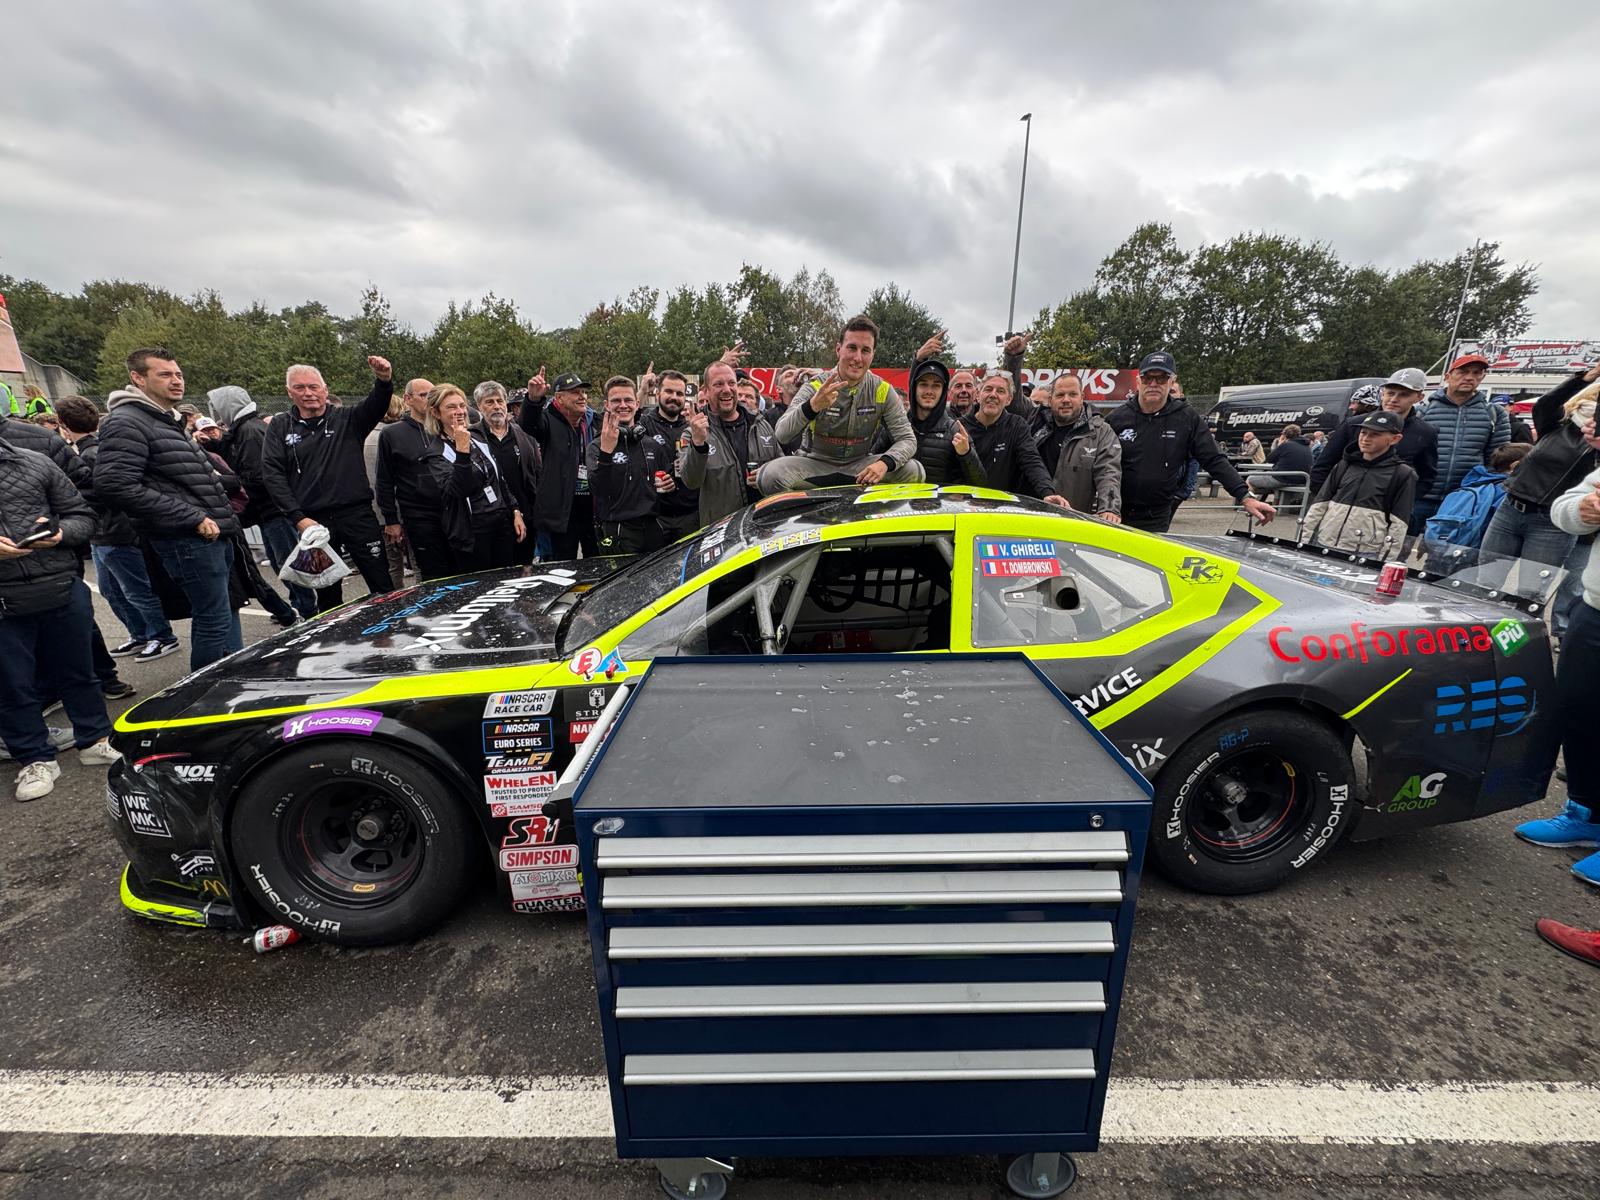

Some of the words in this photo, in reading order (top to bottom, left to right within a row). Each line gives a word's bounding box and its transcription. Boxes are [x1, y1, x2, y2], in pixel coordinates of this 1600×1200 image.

[1020, 368, 1119, 394] DRKS
[1227, 410, 1303, 427] Speedwear
[1000, 544, 1009, 556] V.
[1011, 544, 1055, 556] GHIRELLI
[1009, 561, 1053, 574] DOMBROWSKI
[1268, 620, 1491, 663] Conforama
[508, 693, 546, 704] NASCAR
[494, 706, 520, 714] RACE
[523, 704, 543, 712] CAR
[308, 717, 373, 727] HOOSIER
[505, 723, 540, 734] NASCAR
[494, 739, 515, 748] EURO
[516, 737, 542, 747] SERIES
[486, 773, 554, 789] WHELEN
[1170, 751, 1220, 823] HOOSIER
[1392, 772, 1448, 801] AG
[371, 765, 440, 833] HOOSIER
[1387, 798, 1437, 813] GROUP
[1290, 801, 1345, 869] HOOSIER
[507, 849, 572, 867] SIMPSON
[250, 863, 320, 932] HOOSIER
[515, 897, 581, 911] QUARTER
